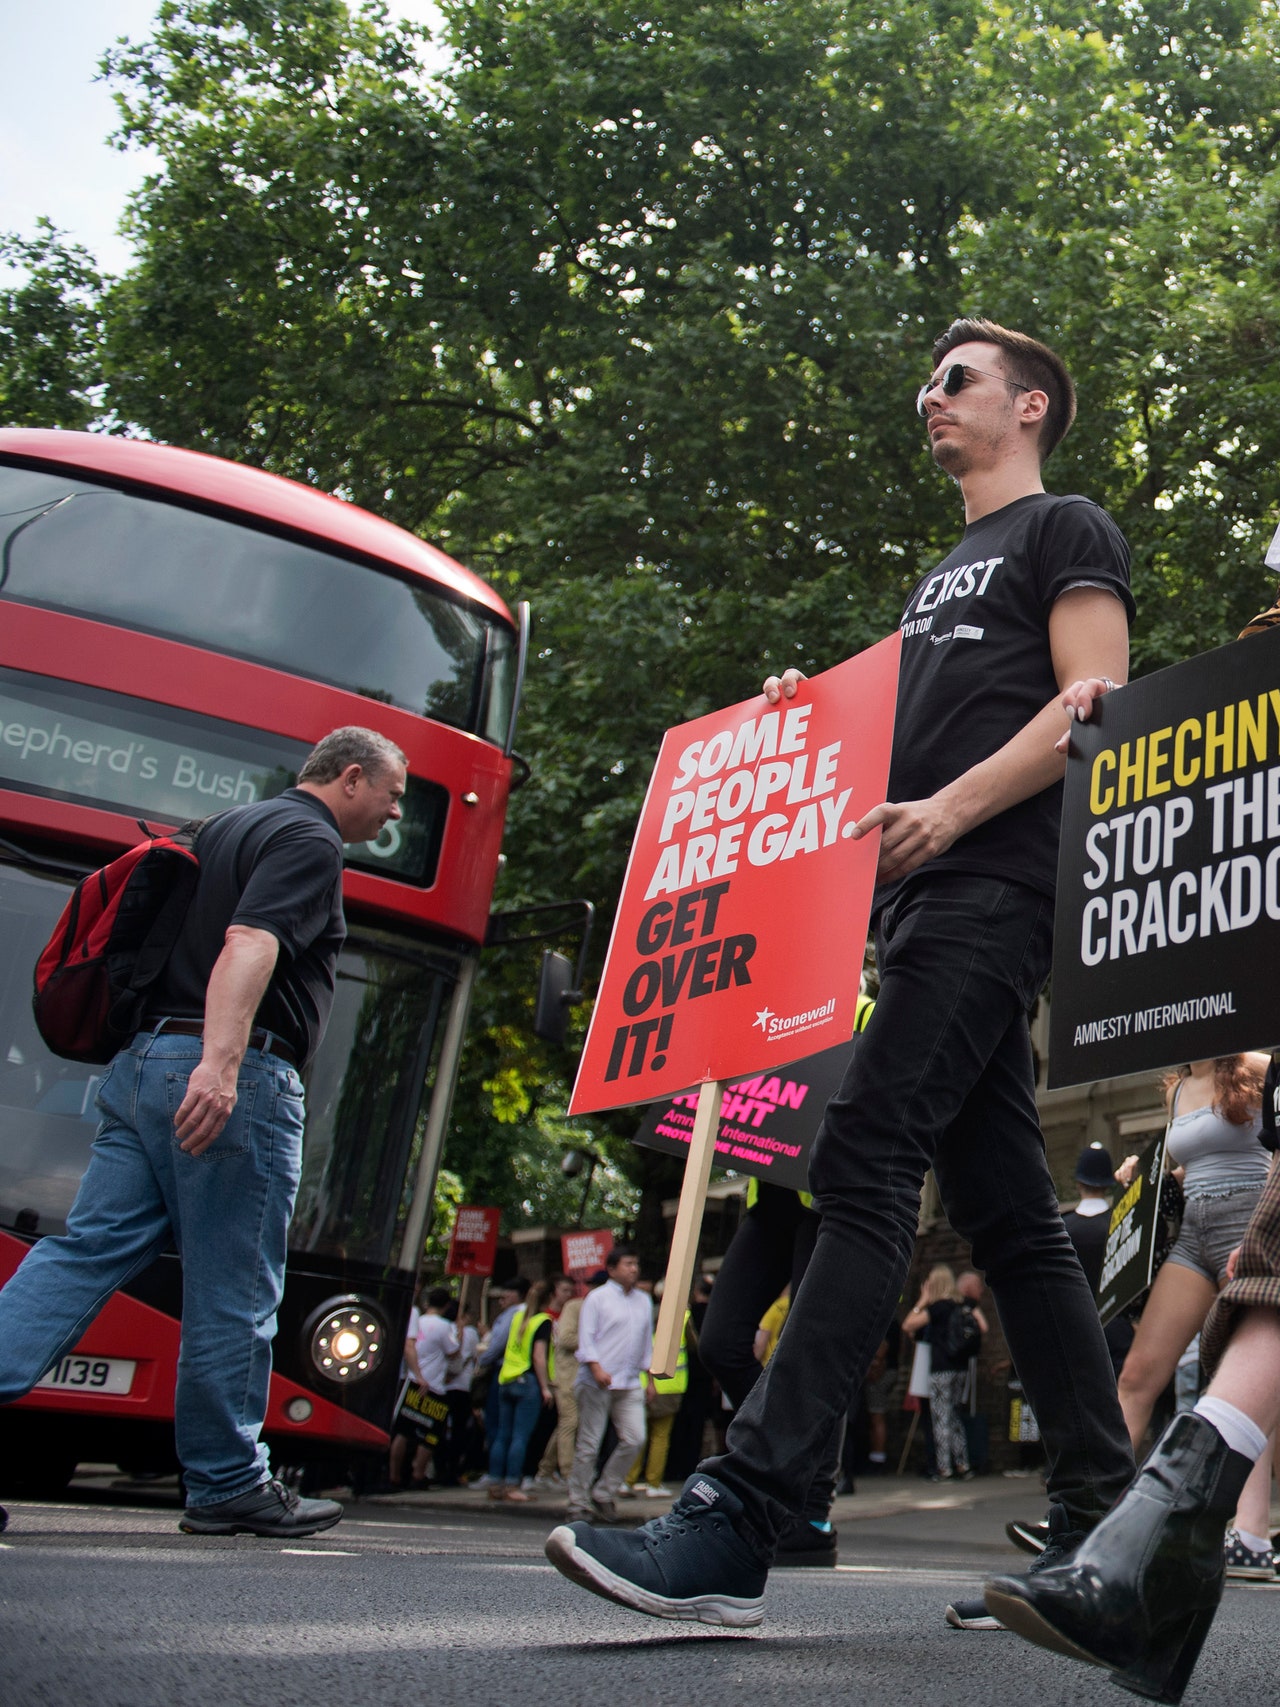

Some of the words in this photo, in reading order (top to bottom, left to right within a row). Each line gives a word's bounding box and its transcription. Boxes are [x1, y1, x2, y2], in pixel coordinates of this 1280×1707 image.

[915, 556, 1004, 613] EXIST
[672, 703, 813, 791] SOME
[172, 755, 256, 803] Bush
[658, 740, 842, 844] PEOPLE
[644, 821, 746, 901] ARE
[747, 787, 855, 867] GAY.
[1083, 796, 1194, 891] STOP
[636, 881, 730, 956] GET
[622, 933, 757, 1018] OVER
[767, 1030, 795, 1042] Acceptance
[768, 998, 836, 1033] Stonewall
[1074, 1016, 1132, 1047] AMNESTY
[1134, 992, 1236, 1033] INTERNATIONAL
[604, 1012, 674, 1083] IT!
[728, 1075, 809, 1110] MAN
[721, 1123, 802, 1158] International
[731, 1144, 774, 1166] HUMAN
[694, 1480, 720, 1501] FABRIC
